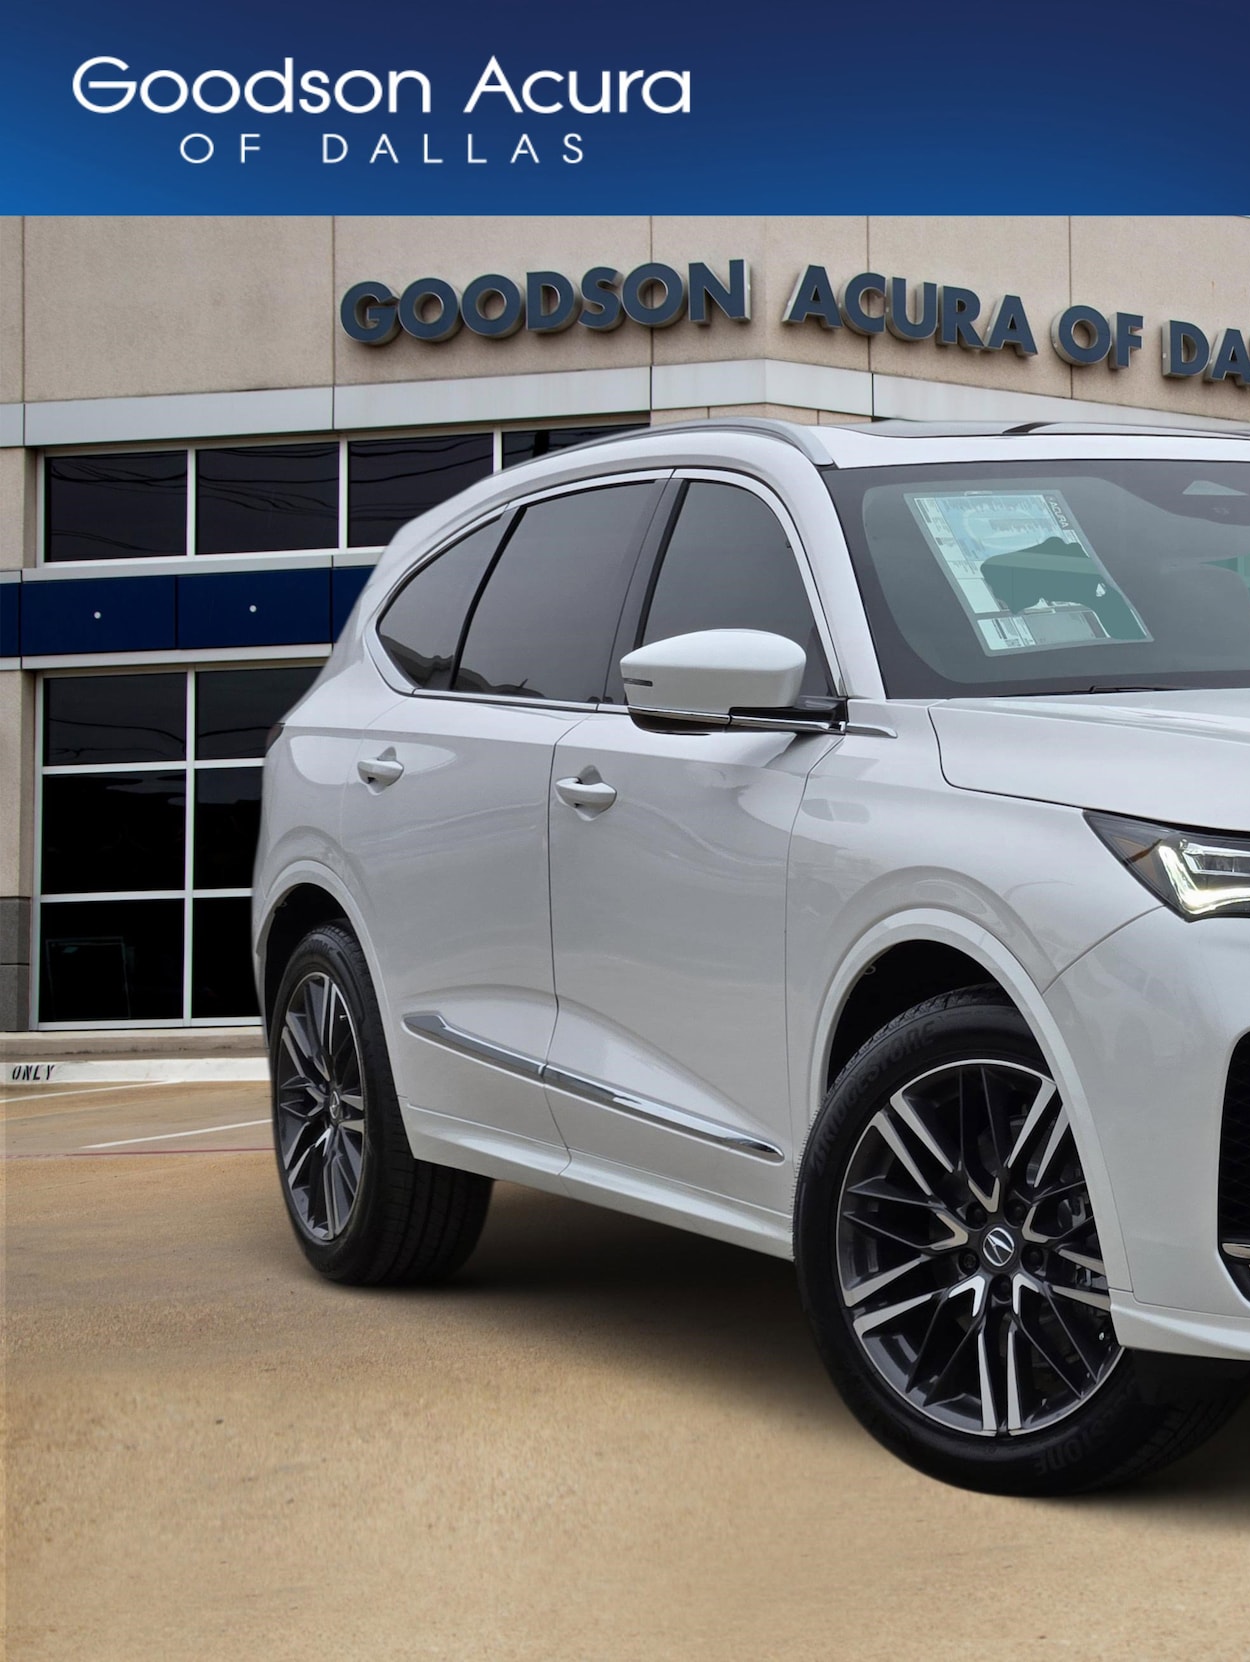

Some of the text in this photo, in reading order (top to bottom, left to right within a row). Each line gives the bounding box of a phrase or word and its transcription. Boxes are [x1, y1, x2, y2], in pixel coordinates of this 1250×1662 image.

[340, 259, 751, 346] GOODSON
[783, 264, 1038, 358] ACURA
[1051, 304, 1143, 368] OF
[1049, 501, 1069, 528] ACURA
[12, 1065, 55, 1081] ONLY
